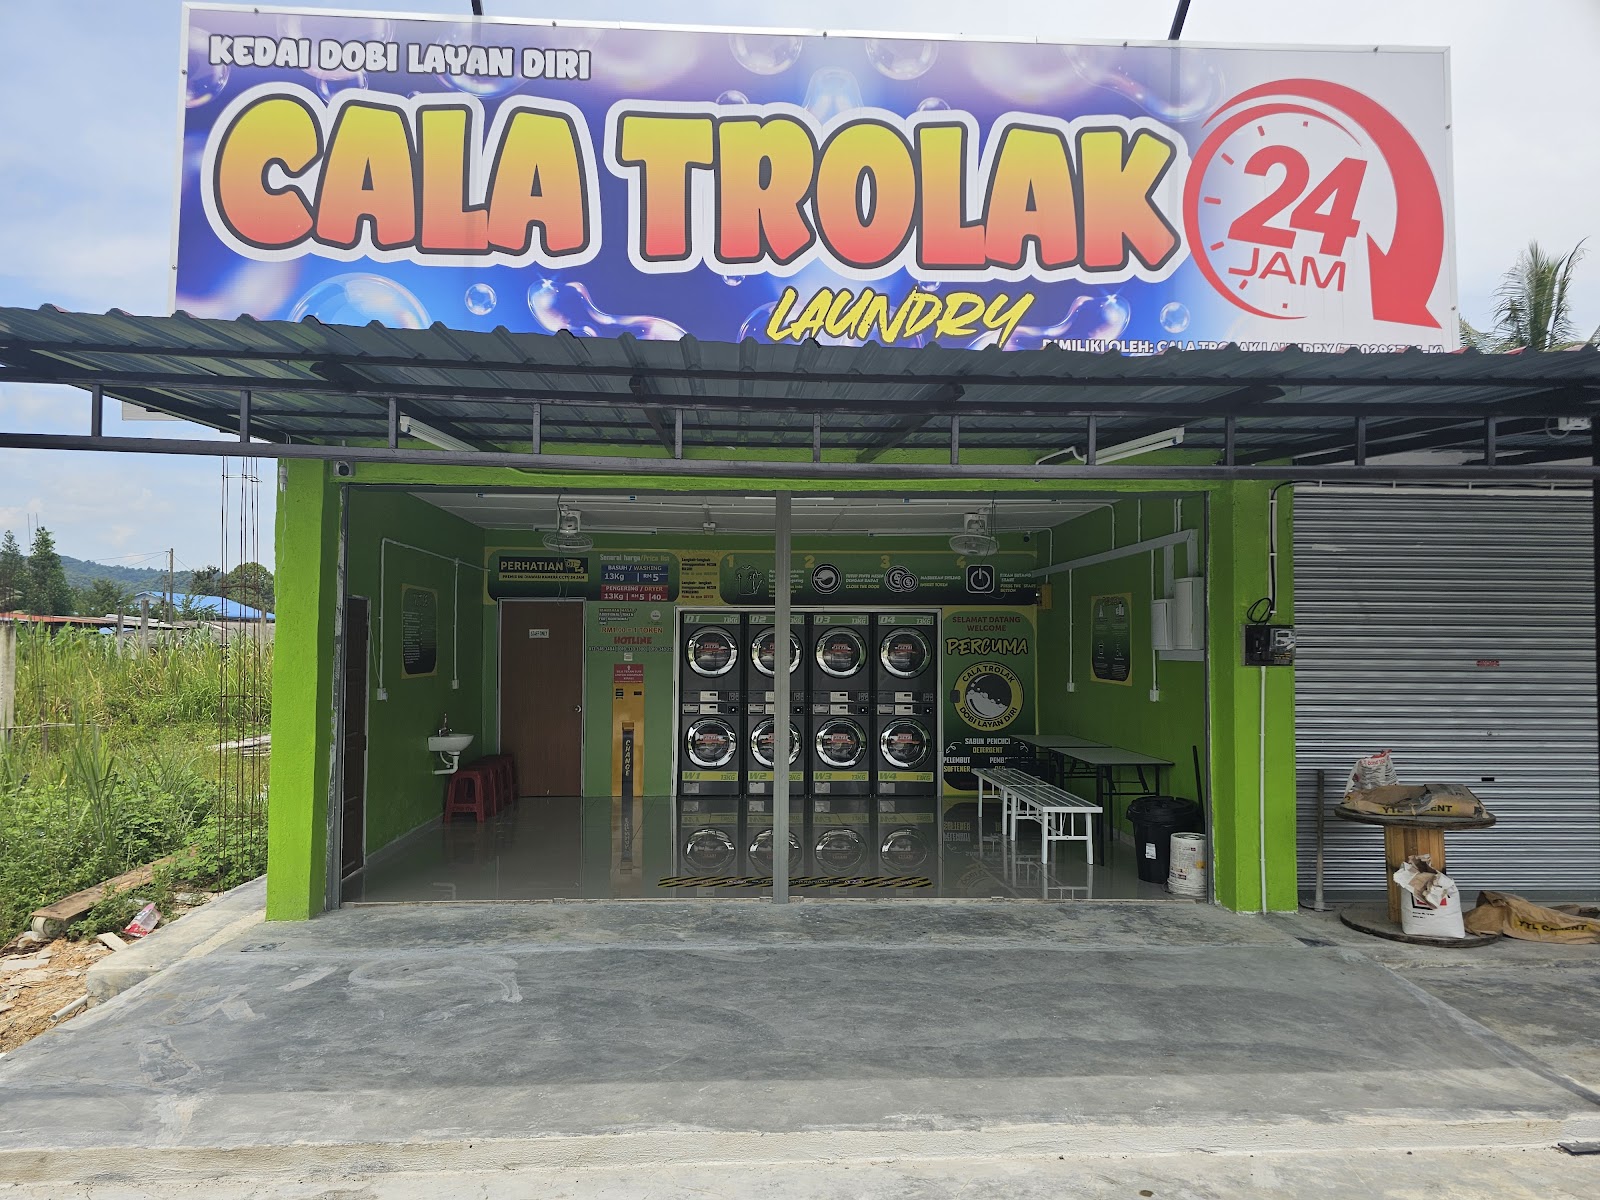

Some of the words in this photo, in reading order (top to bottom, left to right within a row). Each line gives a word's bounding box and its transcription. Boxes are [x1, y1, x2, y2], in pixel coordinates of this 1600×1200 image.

[209, 34, 311, 68] KEDAI
[318, 39, 399, 72] DOBI
[406, 43, 514, 77] LAYAN
[521, 48, 591, 80] DIRI
[212, 93, 590, 257] CALA
[616, 110, 1182, 273] TROLAK
[1227, 145, 1367, 257] 24
[1228, 247, 1346, 292] JAM
[766, 285, 1035, 348] LAUNDRY
[500, 561, 563, 571] PERHATIAN
[727, 555, 734, 568] 1
[804, 555, 815, 568] 2
[880, 555, 890, 568] 3
[956, 556, 966, 568] 4
[604, 573, 625, 581] 13Kg
[945, 637, 1028, 655] PERCUMA
[962, 667, 982, 682] CALA
[983, 666, 1015, 683] TROLAK
[960, 707, 977, 724] DOBI
[978, 719, 1004, 728] LAYAN
[1004, 707, 1018, 722] DIRI
[1519, 920, 1538, 930] YTL
